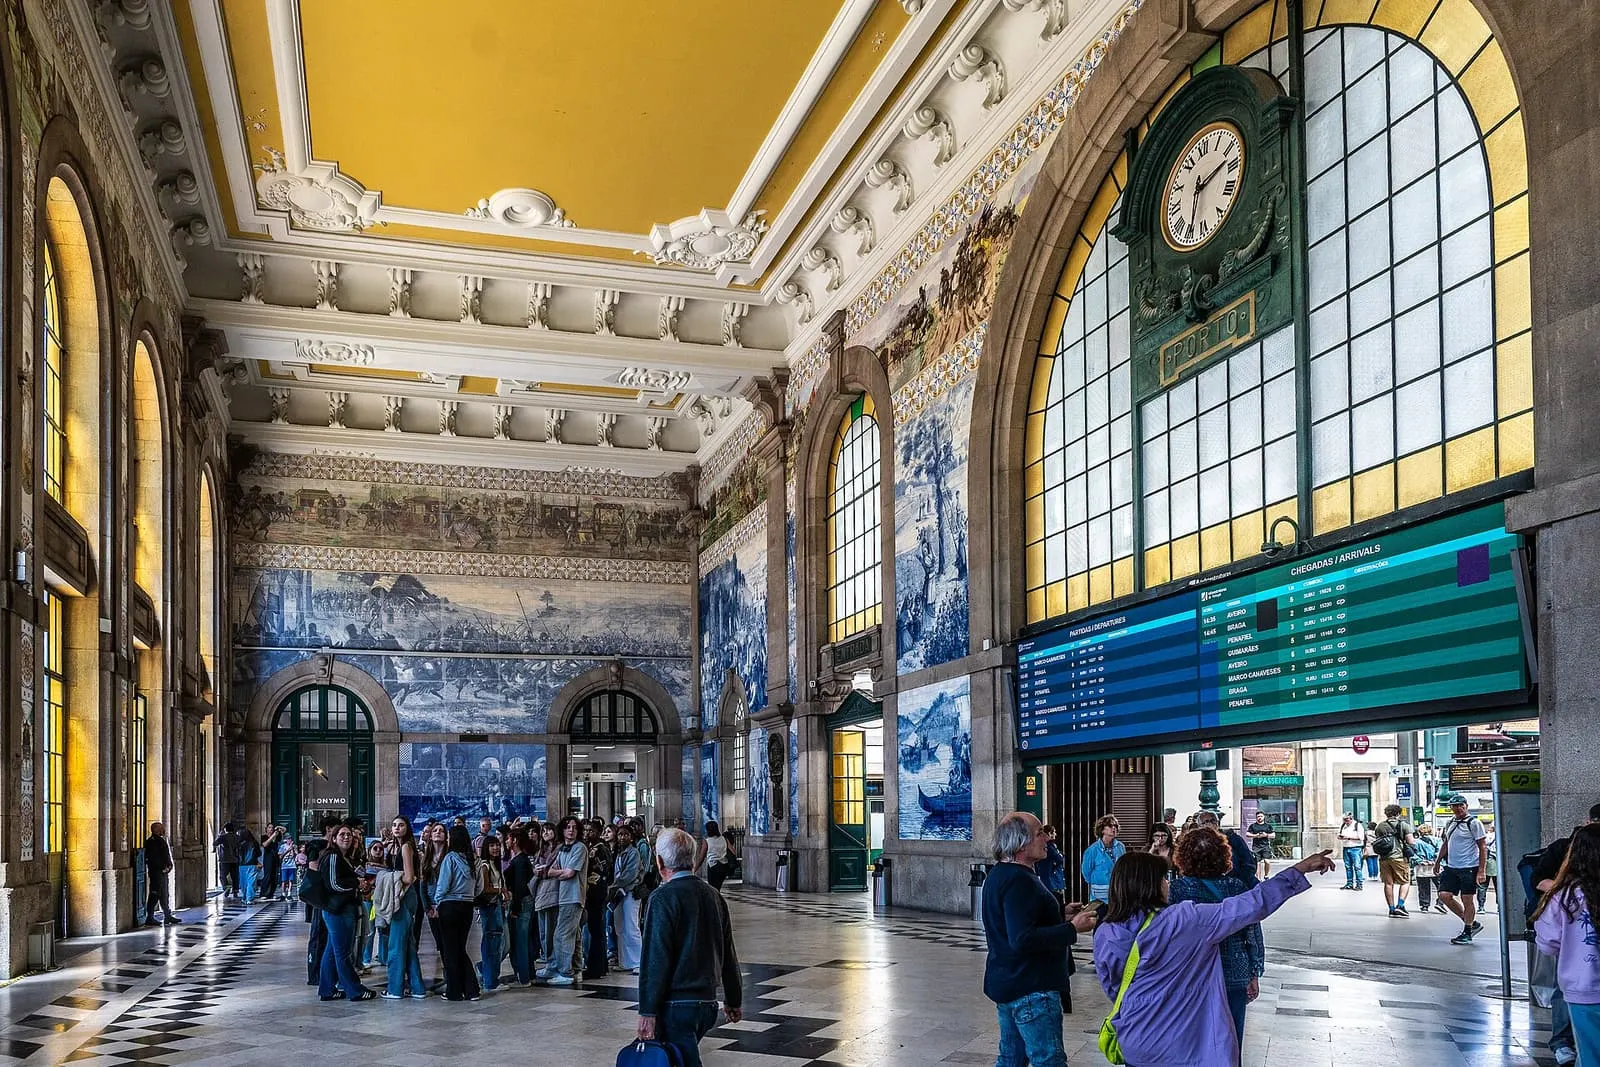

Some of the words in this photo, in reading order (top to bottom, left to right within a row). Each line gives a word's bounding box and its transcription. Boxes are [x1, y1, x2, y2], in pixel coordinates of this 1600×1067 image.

[1215, 135, 1222, 151] I
[1223, 140, 1235, 157] II
[1197, 139, 1209, 161] XII
[1227, 156, 1239, 174] III
[1174, 182, 1184, 192] X
[1223, 179, 1236, 196] IIII
[1173, 310, 1238, 366] PORTO
[1290, 557, 1334, 576] CHEGADAS
[1339, 544, 1381, 564] ARRIVALS
[1227, 608, 1247, 619] AVEIRO
[1069, 624, 1091, 638] PARTIDAS
[1094, 616, 1126, 630] DEPARTURES
[1227, 621, 1247, 632] BRAGA
[1227, 633, 1253, 644] PENAFIEL
[1227, 645, 1259, 657] GUIMARÃES
[1227, 660, 1248, 670] AVEIRO
[1228, 672, 1248, 682] MARCO
[1248, 667, 1282, 680] CANAVESES
[1228, 686, 1248, 695] BRAGA
[1228, 698, 1254, 708] PENAFIEL
[1243, 777, 1258, 785] THE
[1258, 776, 1298, 785] PASSENGER
